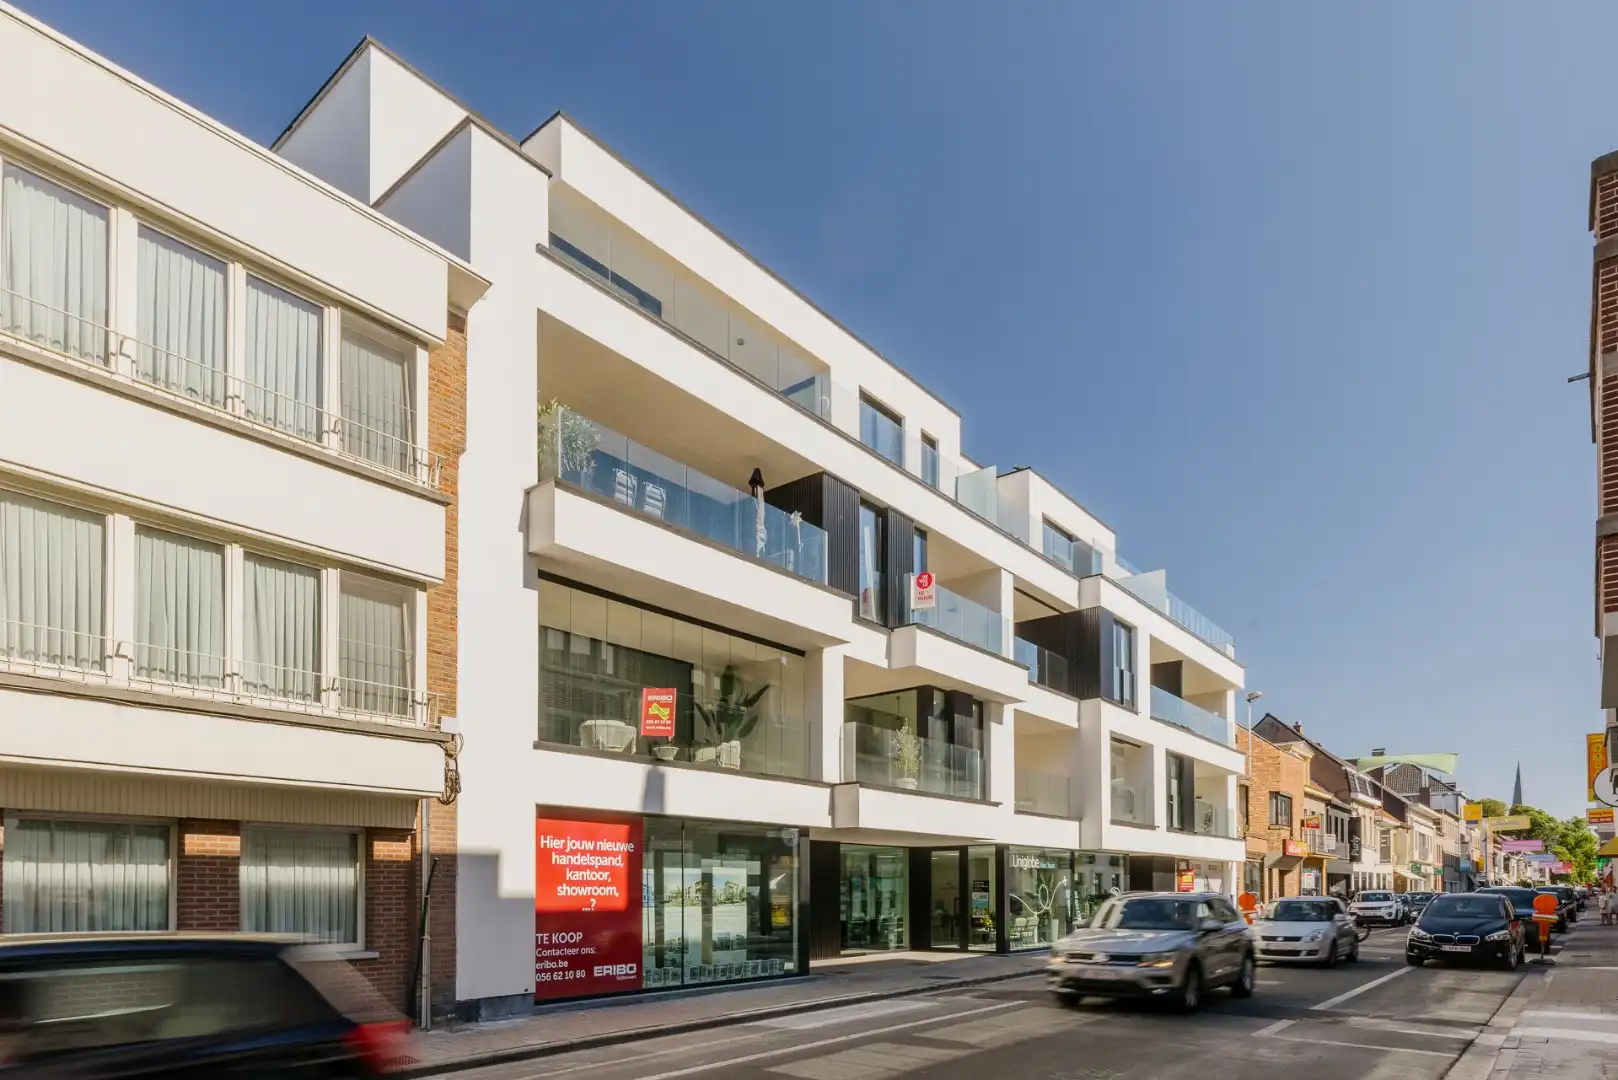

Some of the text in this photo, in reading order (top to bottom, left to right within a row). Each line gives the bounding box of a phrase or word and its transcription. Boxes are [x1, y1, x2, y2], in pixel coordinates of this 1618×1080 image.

[540, 835, 635, 853] Hier jouw nieuwe
[551, 852, 625, 869] handelspand,
[1012, 853, 1040, 870] Uniglobe
[566, 868, 612, 883] kantoor,
[556, 883, 619, 897] showroom,
[536, 932, 583, 945] TE KOOP
[536, 946, 580, 957] Contacteer
[536, 959, 569, 970] eribo.be
[593, 963, 637, 977] ERIBO
[536, 969, 586, 982] 056 62 10 80
